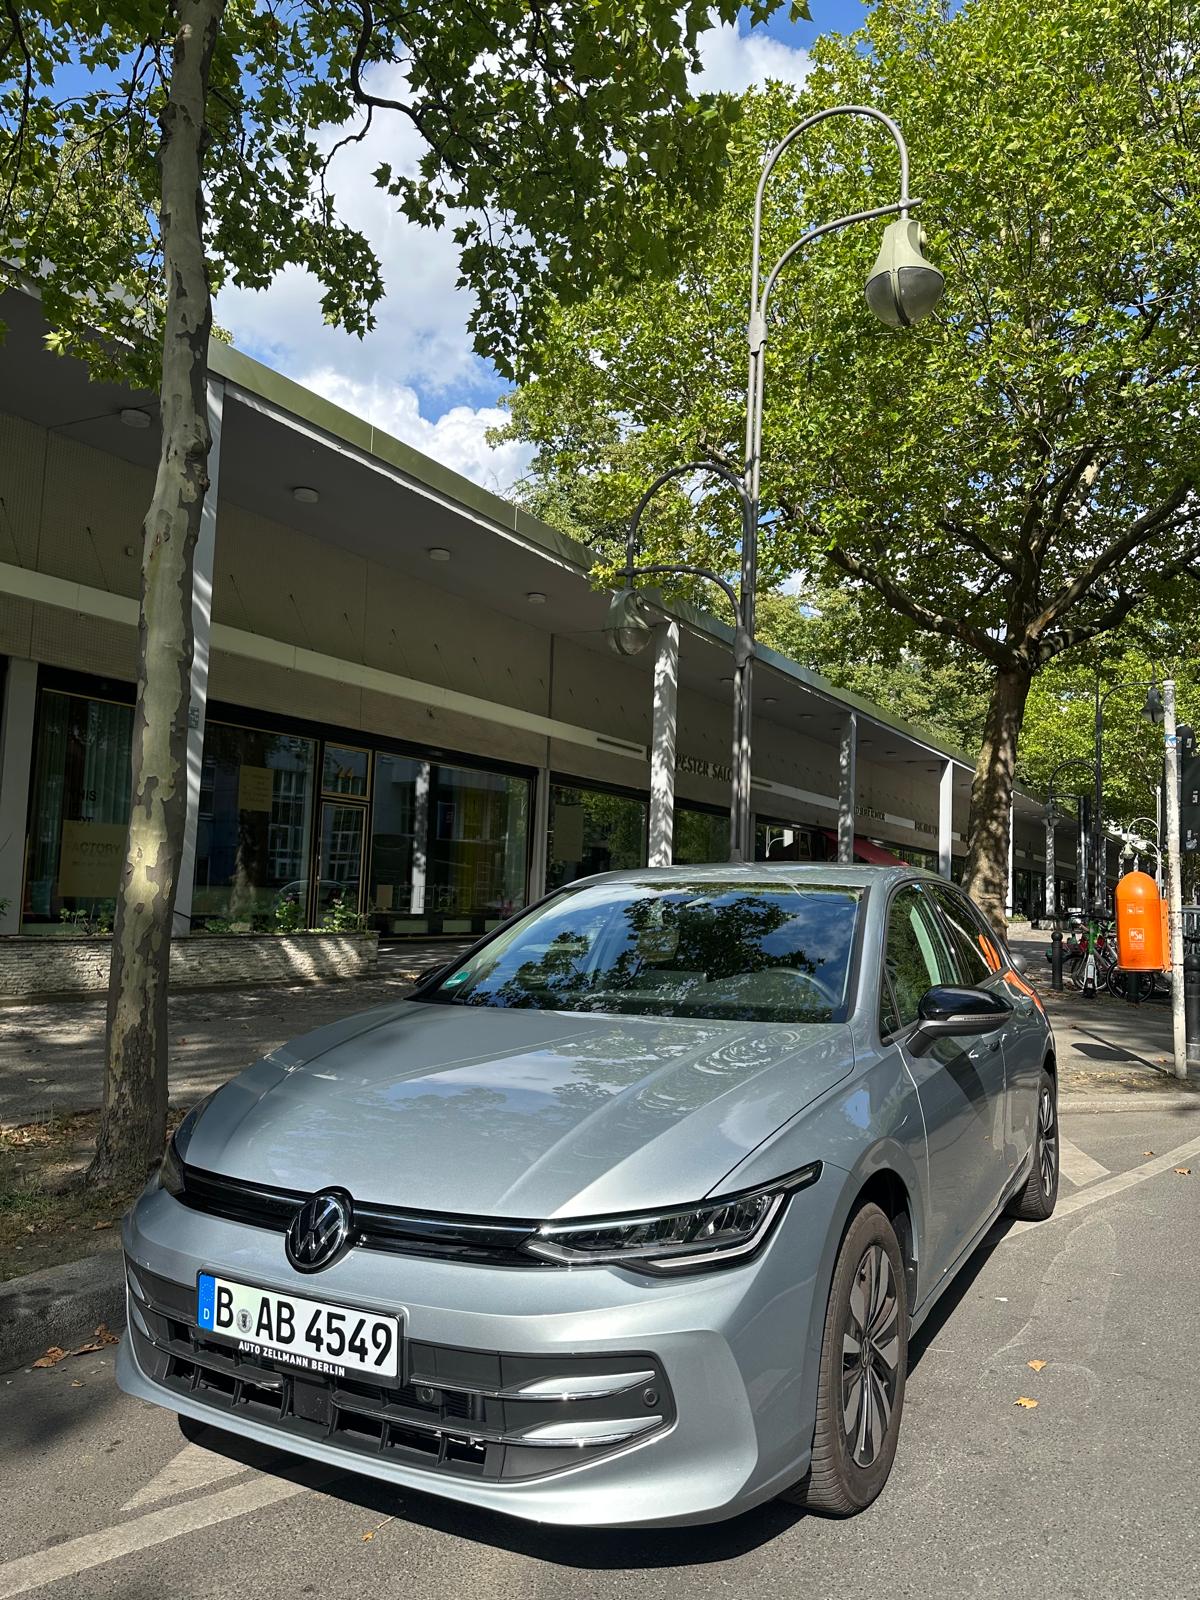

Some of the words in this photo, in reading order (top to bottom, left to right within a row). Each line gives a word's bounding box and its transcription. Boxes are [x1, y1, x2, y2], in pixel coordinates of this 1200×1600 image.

[712, 763, 733, 783] SALO
[203, 1307, 210, 1320] D
[216, 1285, 234, 1328] B
[255, 1296, 295, 1345] AB
[305, 1308, 392, 1367] 4549
[238, 1340, 260, 1355] AUTO
[262, 1347, 309, 1369] ZELLMANN
[311, 1359, 346, 1377] BERLIN
